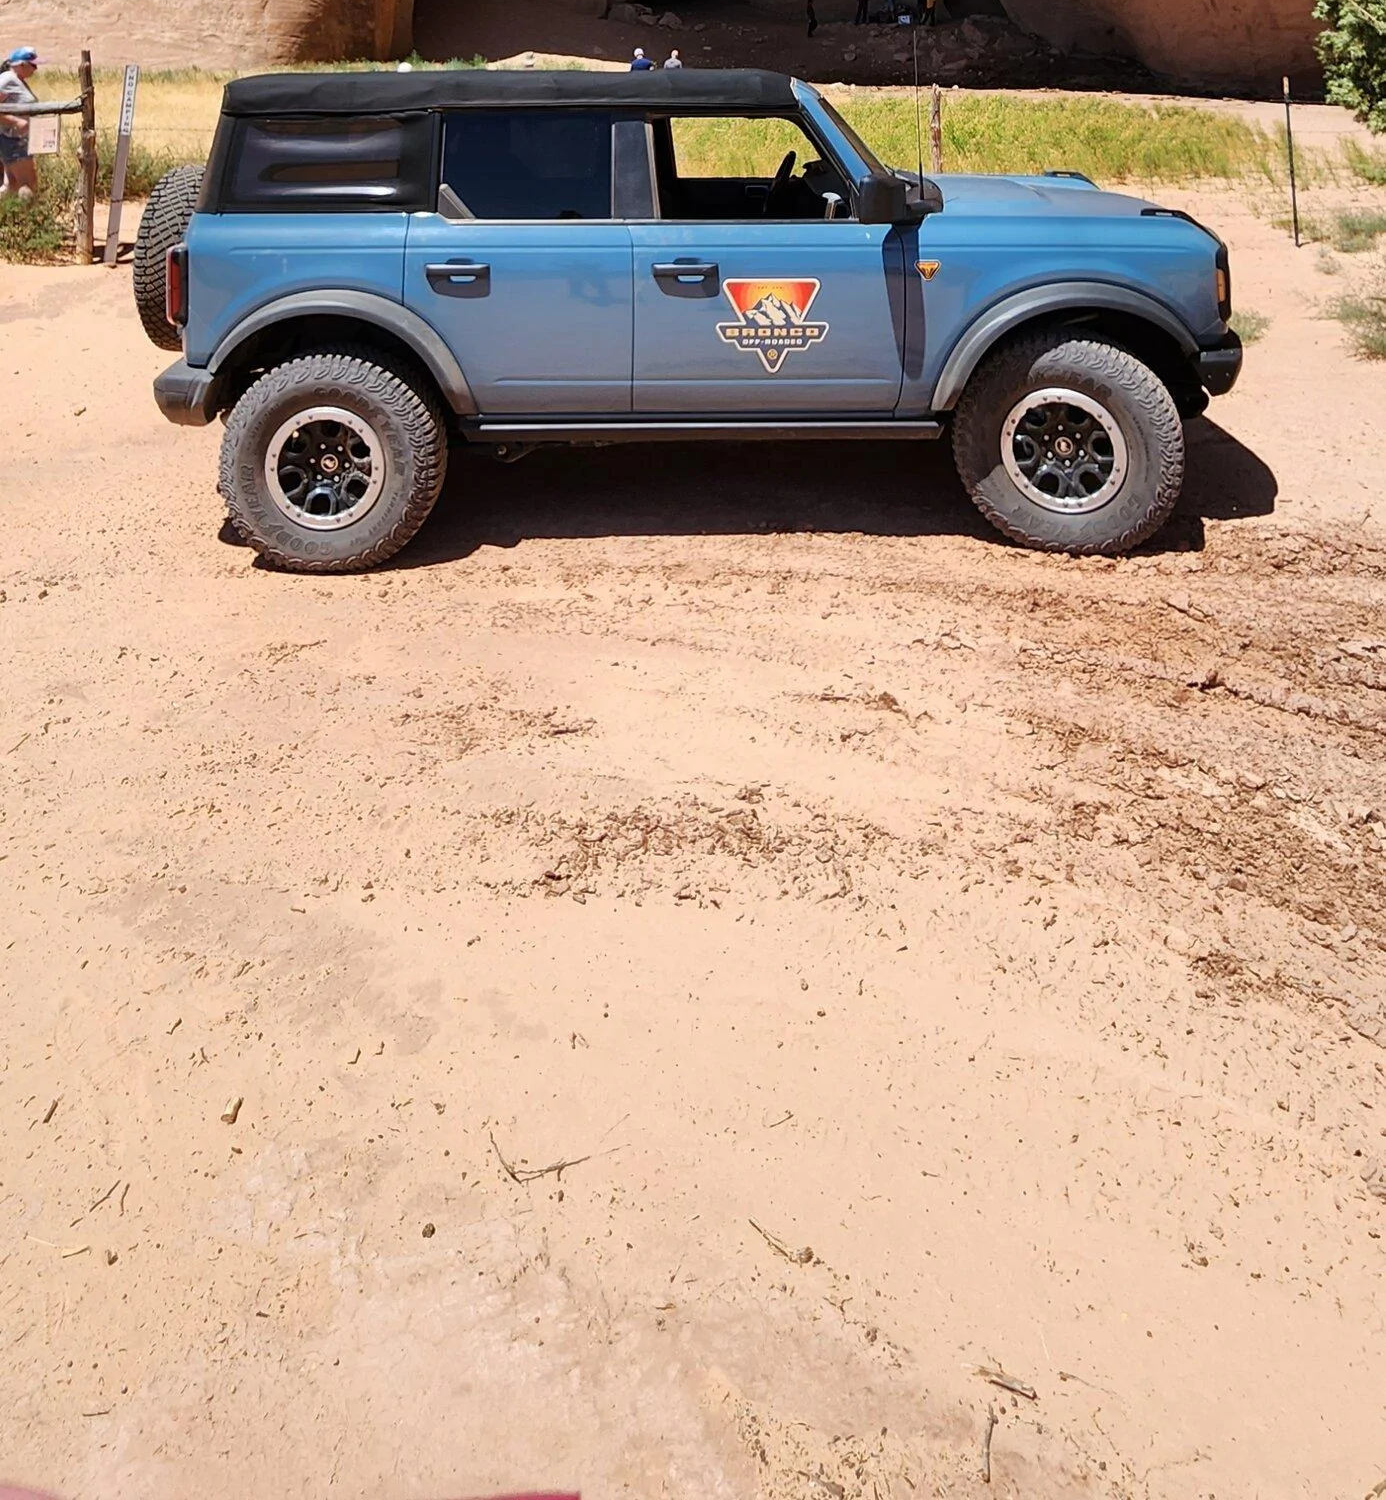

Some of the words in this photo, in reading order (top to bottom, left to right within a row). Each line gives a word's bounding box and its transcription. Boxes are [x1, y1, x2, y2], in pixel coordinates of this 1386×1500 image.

[128, 75, 134, 87] NO
[123, 91, 132, 133] CAMPING
[725, 327, 819, 337] BRONCO
[240, 464, 333, 556] GOODYEAR
